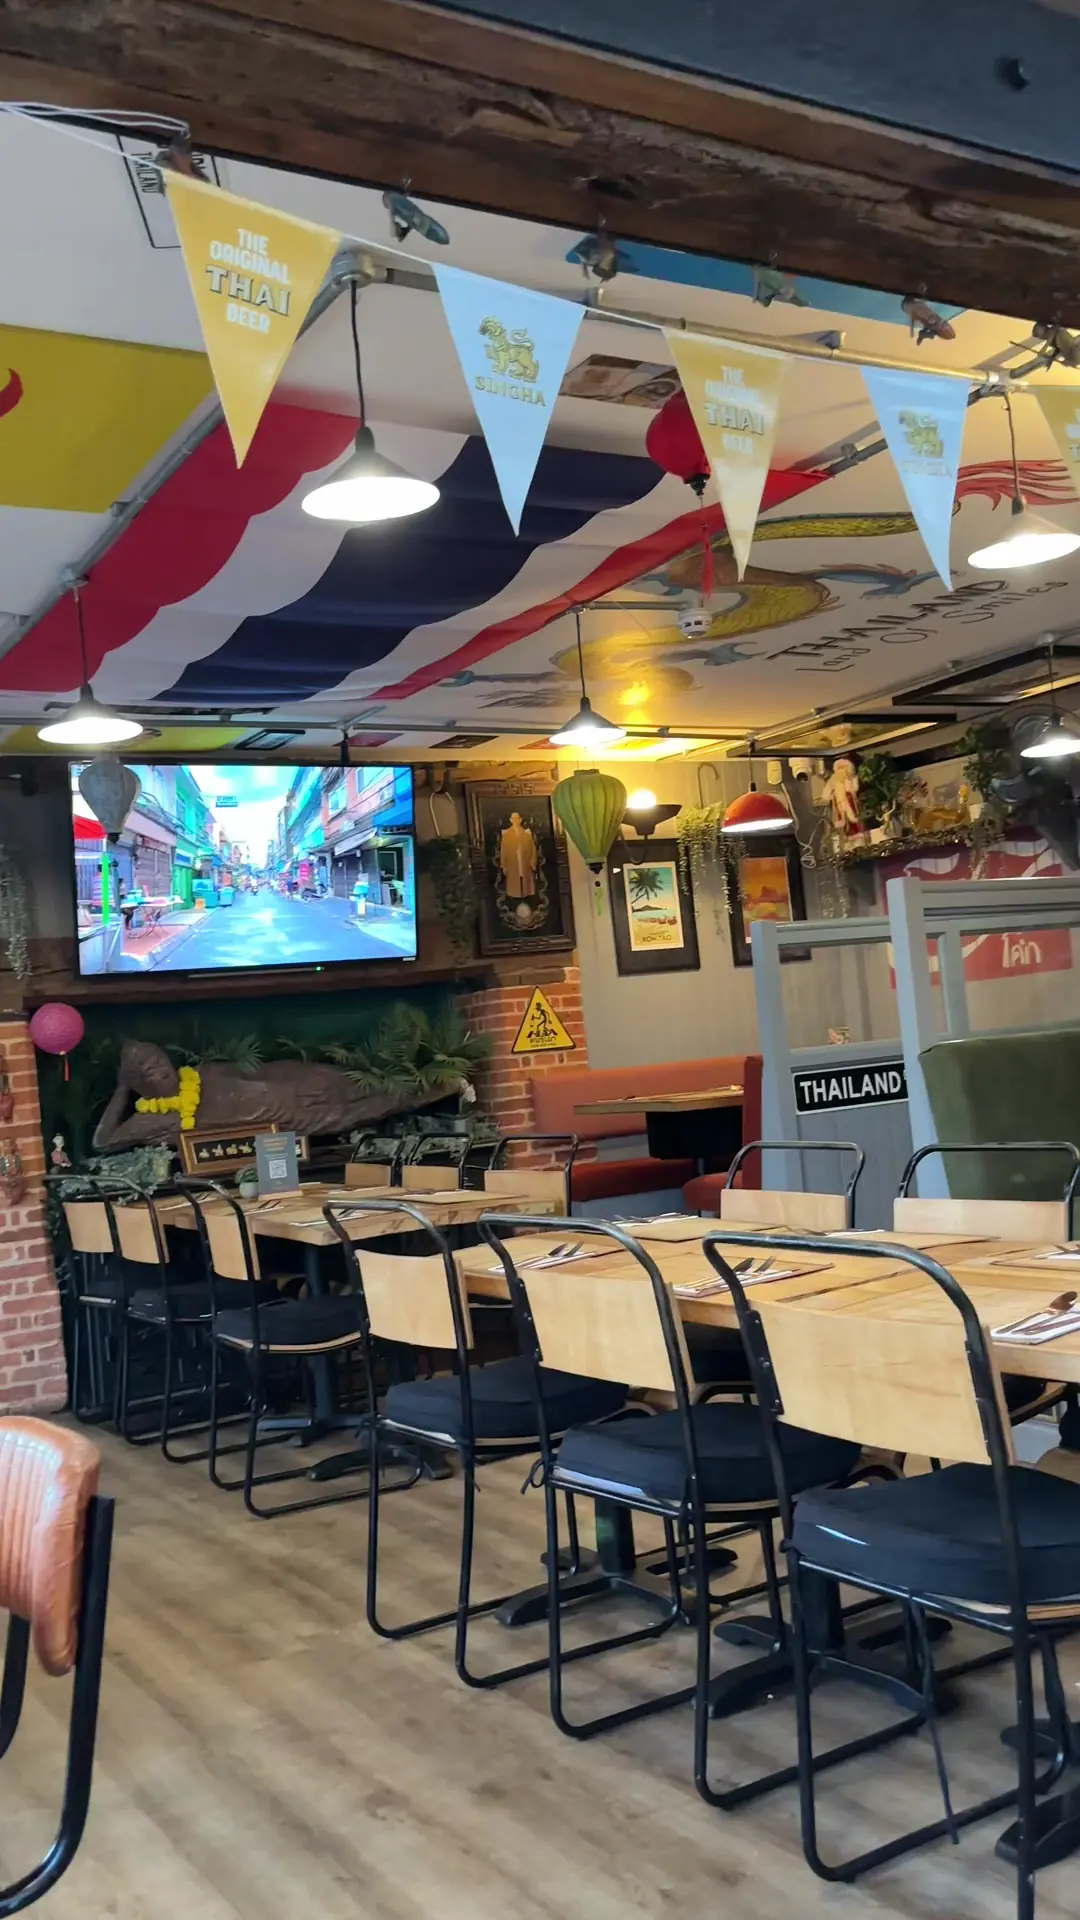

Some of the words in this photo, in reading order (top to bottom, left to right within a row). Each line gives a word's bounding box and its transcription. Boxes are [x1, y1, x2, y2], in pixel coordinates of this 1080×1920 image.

[237, 228, 269, 256] THE
[209, 240, 291, 285] ORIGINAL
[205, 264, 290, 317] THAI
[226, 302, 270, 334] BEER
[475, 375, 546, 407] SINGHA
[704, 401, 764, 436] THAI
[766, 579, 1008, 660] THAILAND
[795, 647, 872, 672] Land
[942, 580, 1069, 624] Smiles
[799, 1070, 902, 1105] THAILAND
